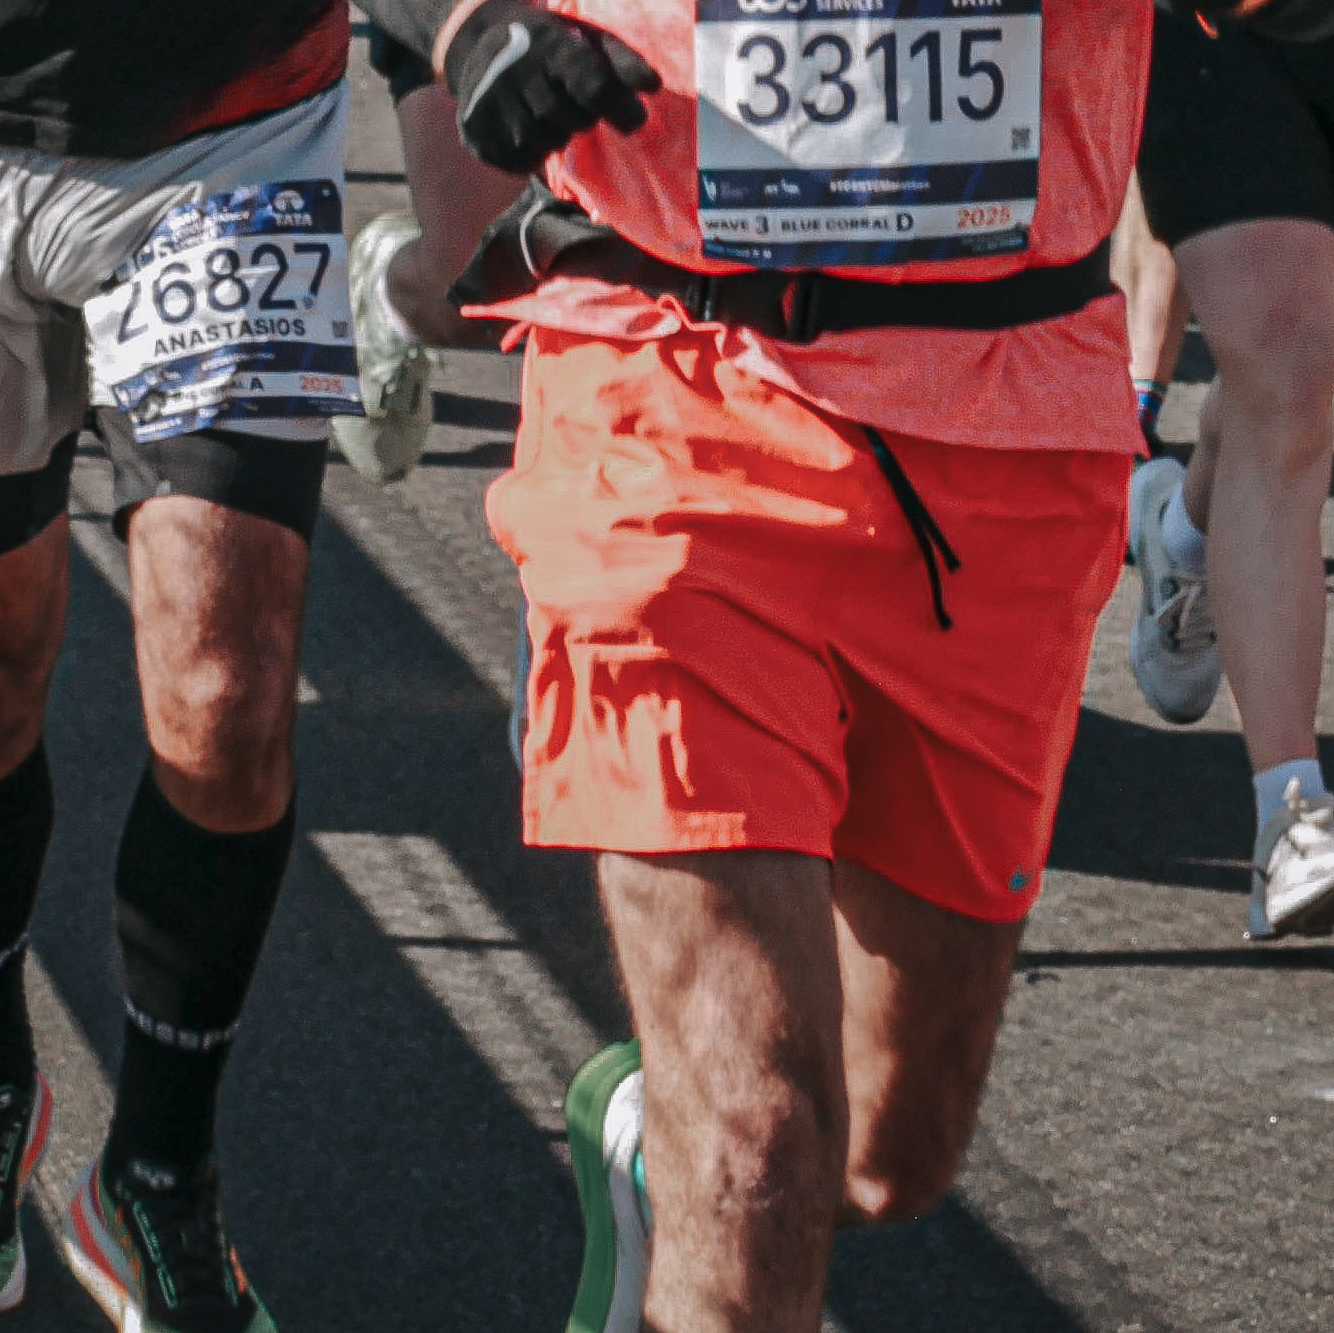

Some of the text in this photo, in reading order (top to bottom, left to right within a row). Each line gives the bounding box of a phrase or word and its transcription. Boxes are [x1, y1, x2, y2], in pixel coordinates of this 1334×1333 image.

[737, 27, 1005, 125] 33115
[896, 212, 914, 232] D
[117, 243, 332, 346] 26827
[154, 317, 307, 357] ANASTASIOS
